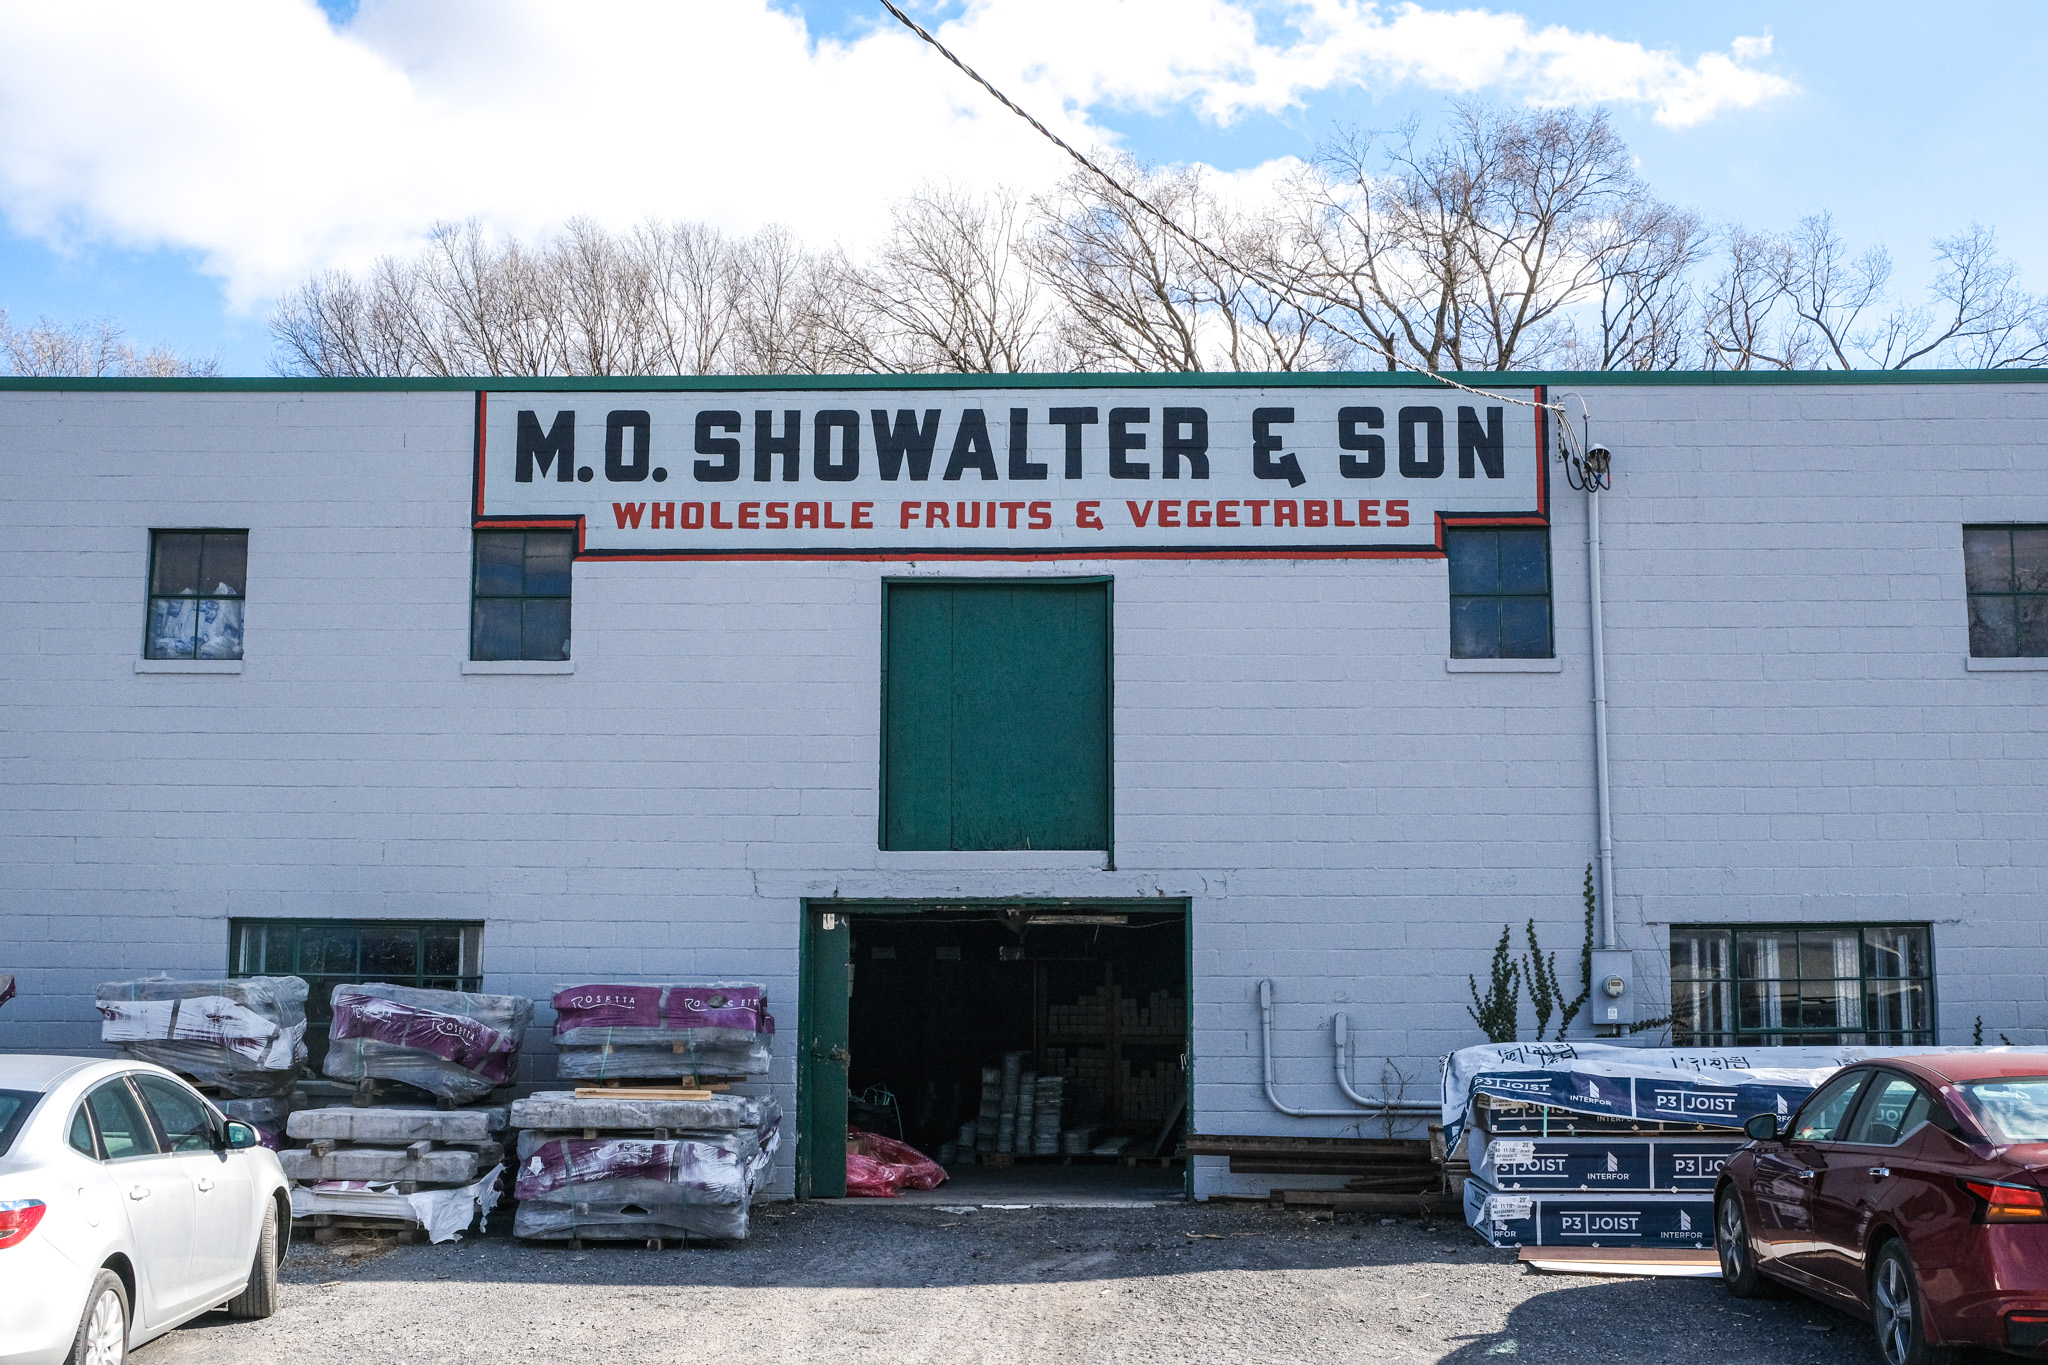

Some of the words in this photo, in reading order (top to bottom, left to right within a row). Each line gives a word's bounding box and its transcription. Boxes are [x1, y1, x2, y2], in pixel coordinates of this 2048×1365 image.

[515, 410, 668, 482] M.O.
[693, 407, 1210, 482] SHOWALTER
[1252, 406, 1306, 488] &
[1337, 406, 1505, 479] SON
[612, 502, 874, 529] WHOLESALE
[900, 501, 1052, 529] FRUITS
[1076, 501, 1104, 531] &
[1127, 500, 1410, 528] VEGETABLES
[570, 995, 635, 1010] ROSETTA
[1474, 1078, 1493, 1087] P3
[1502, 1081, 1550, 1092] JOIST
[1569, 1094, 1612, 1107] INTERFOR
[1656, 1095, 1677, 1108] P3
[1686, 1096, 1736, 1111] JOIST
[1518, 1158, 1566, 1172] JOIST
[1675, 1159, 1696, 1172] P3
[1561, 1217, 1582, 1230] P3
[1591, 1217, 1639, 1230] JOIST
[1660, 1231, 1703, 1239] INTERFOR
